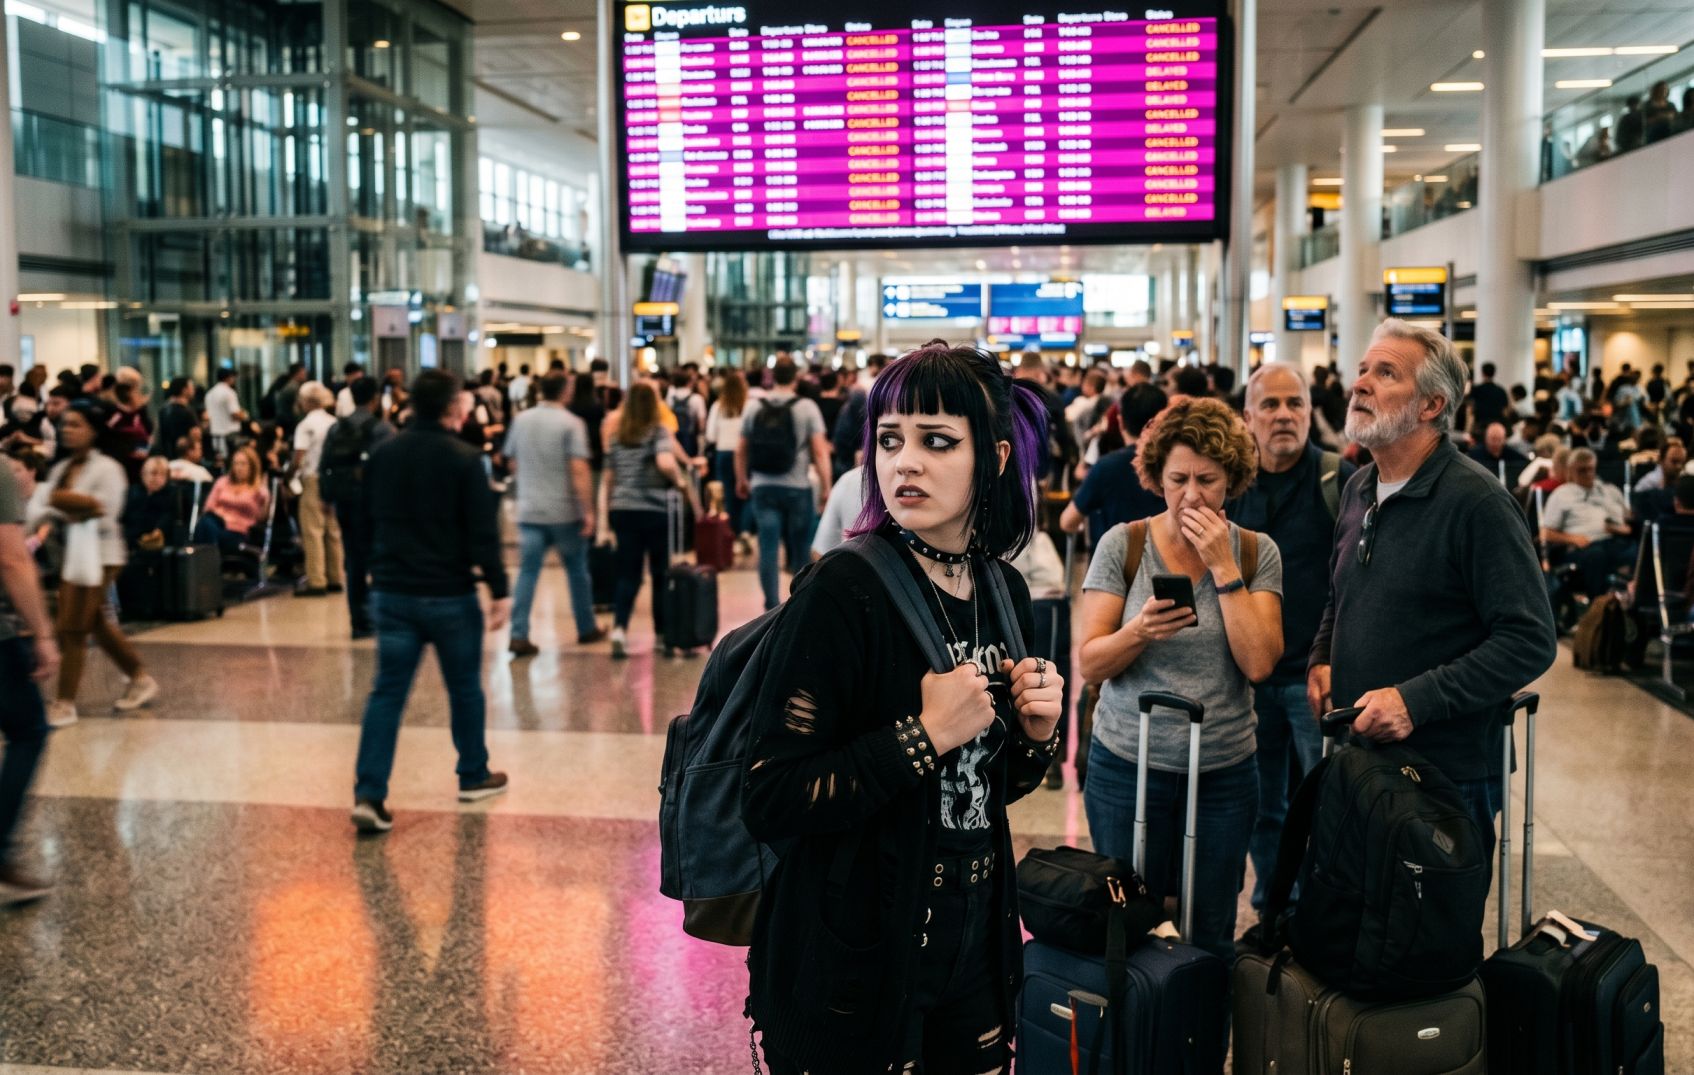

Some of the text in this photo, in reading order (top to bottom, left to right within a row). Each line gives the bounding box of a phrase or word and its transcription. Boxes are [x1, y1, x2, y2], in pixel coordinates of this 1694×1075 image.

[1145, 23, 1200, 34] CANCELLED
[1145, 37, 1200, 48] CANCELLED
[1145, 51, 1200, 62] CANCELLED
[1145, 109, 1199, 119] CANCELLED
[1145, 137, 1198, 148] CANCELLED
[1145, 151, 1199, 162] CANCELLED
[1145, 165, 1198, 176] CANCELLED
[1145, 178, 1198, 190] CANCELLED
[1145, 193, 1198, 204] CANCELLED
